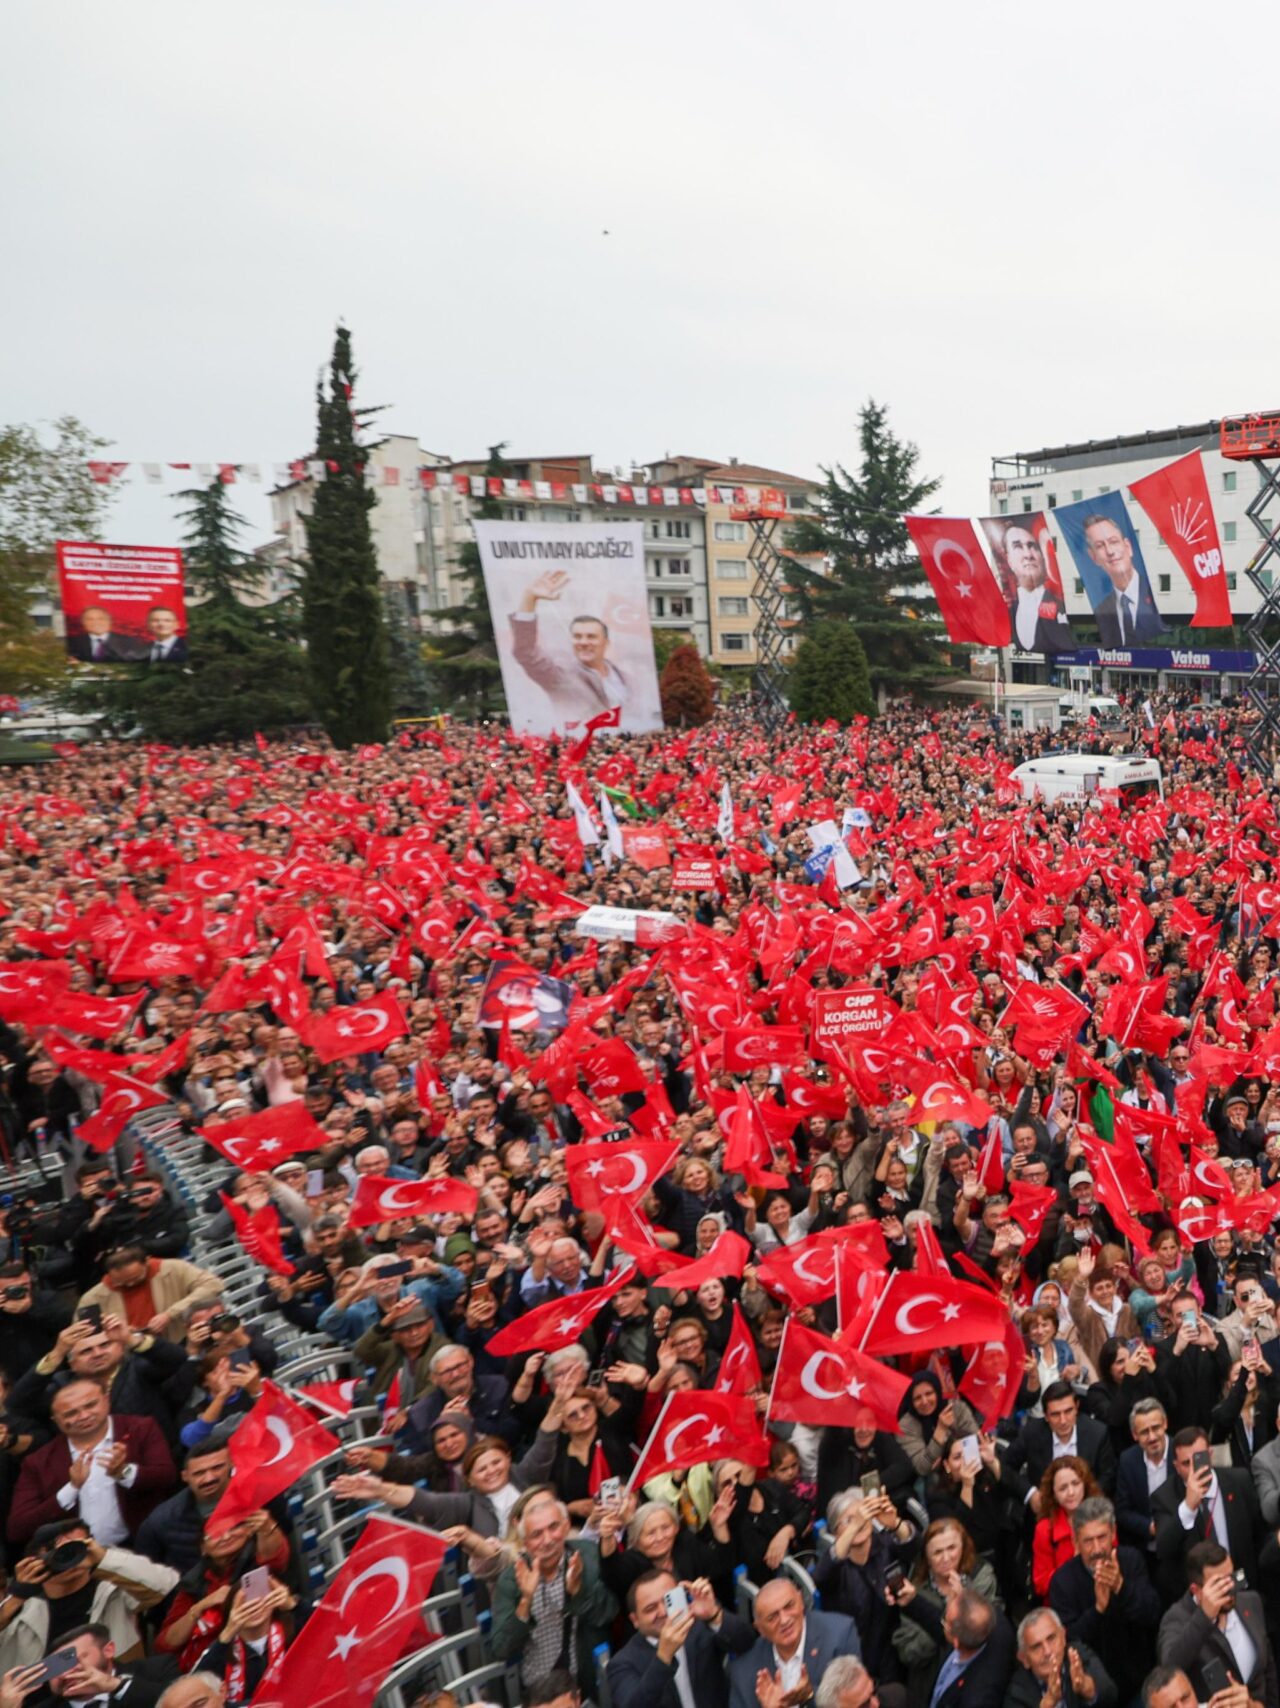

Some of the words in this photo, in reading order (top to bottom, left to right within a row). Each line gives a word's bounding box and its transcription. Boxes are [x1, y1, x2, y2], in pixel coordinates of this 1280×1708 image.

[490, 536, 635, 559] UNUTMAYACAĞIZ!
[1193, 548, 1221, 578] CHP
[1097, 649, 1132, 661] Vatan
[1171, 650, 1210, 664] Vatan
[845, 995, 875, 1007] CHP
[824, 1009, 878, 1024] KORGAN
[819, 1024, 841, 1036] İLÇE
[842, 1020, 882, 1035] ÖRGÜTÜ
